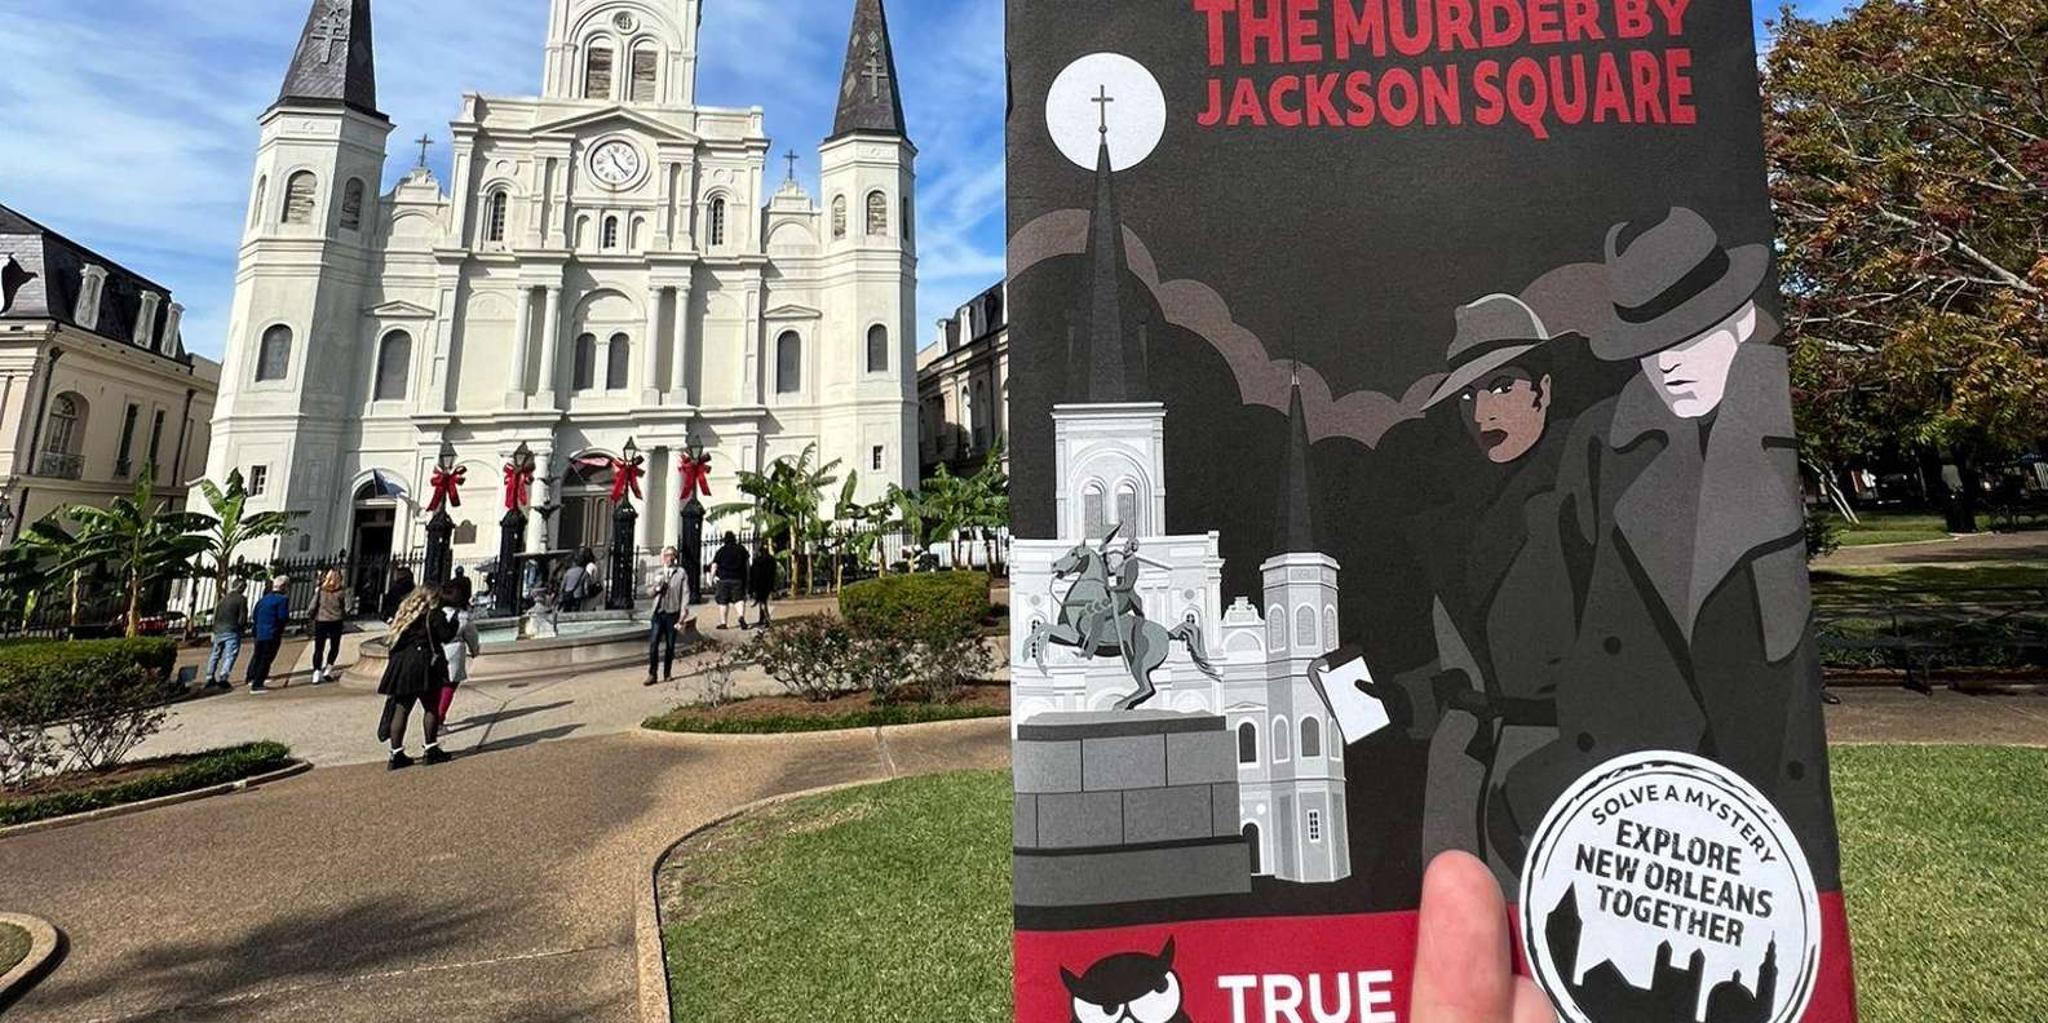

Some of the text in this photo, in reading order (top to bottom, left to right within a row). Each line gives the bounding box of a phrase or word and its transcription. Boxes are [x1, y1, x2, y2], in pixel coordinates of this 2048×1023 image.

[1194, 0, 1690, 66] THE MURDER BY
[1198, 48, 1698, 139] JACKSON SQUARE
[1592, 784, 1777, 865] SOLVE A MYSTERY
[1616, 818, 1742, 875] EXPLORE
[1574, 843, 1773, 918] NEW ORLEANS
[1596, 884, 1744, 946] TOGETHER
[1217, 970, 1397, 1023] TRUE
